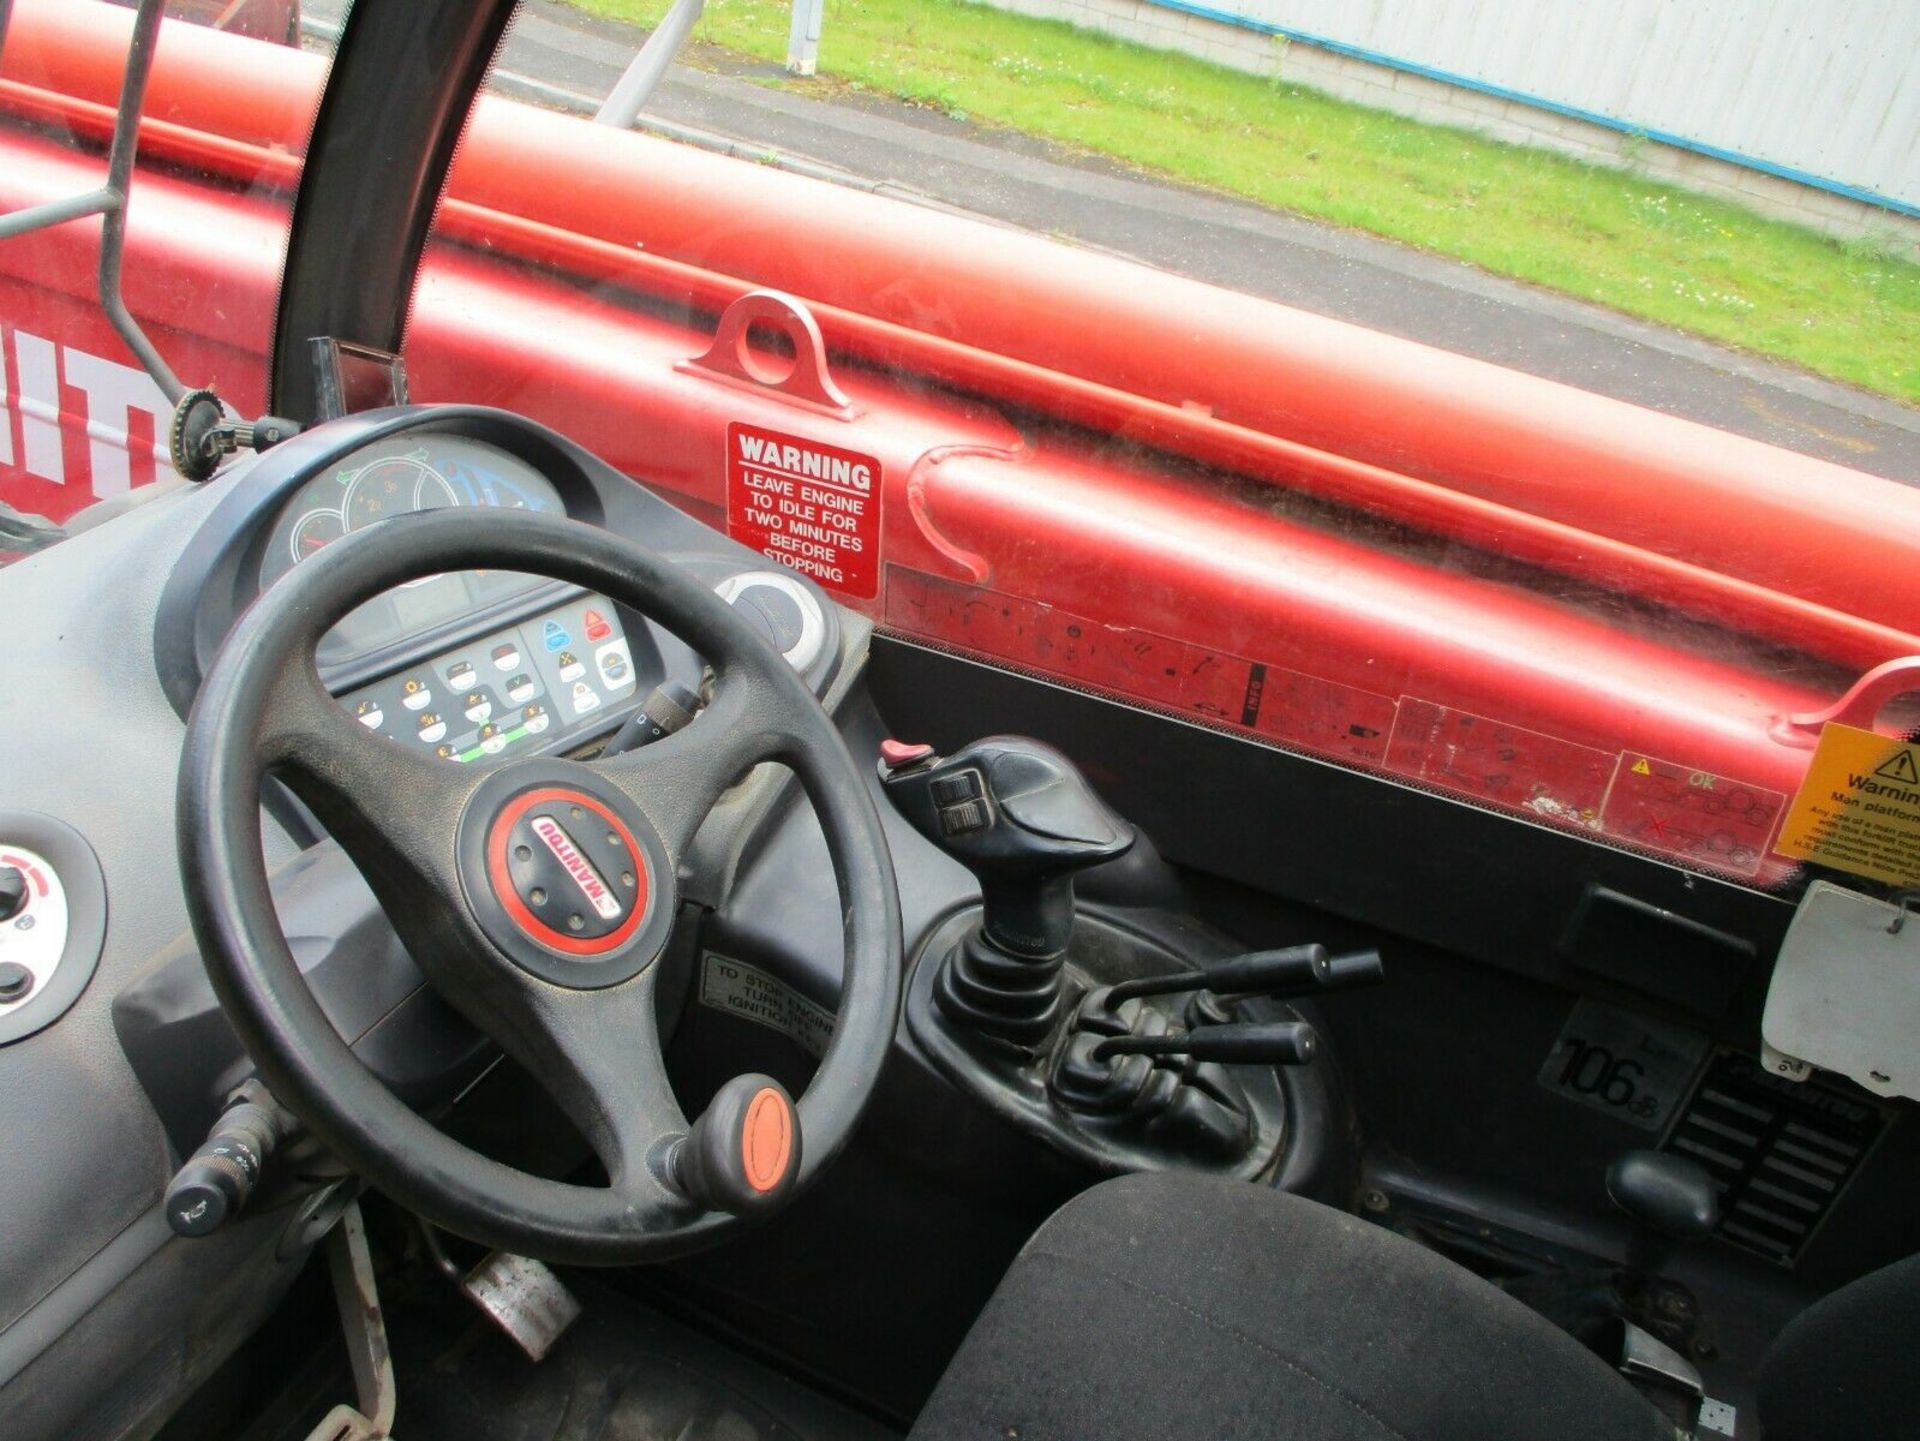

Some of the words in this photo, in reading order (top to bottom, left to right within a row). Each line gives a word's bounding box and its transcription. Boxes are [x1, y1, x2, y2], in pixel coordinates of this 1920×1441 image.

[738, 433, 871, 490] WARNING
[743, 471, 794, 496] LEAVE
[801, 486, 864, 515] ENGINE
[751, 490, 773, 509] TO
[779, 498, 815, 522] IDLE
[821, 509, 857, 532] FOR
[744, 507, 783, 528] TWO
[789, 519, 863, 552] MINUTES
[770, 531, 836, 563] BEFORE
[763, 547, 843, 583] STOPPING
[1688, 771, 1717, 790] OK
[1831, 790, 1860, 808] Man
[1848, 773, 1920, 805] Warnin
[538, 822, 606, 899] MANITOU
[717, 965, 739, 980] TO
[745, 974, 783, 997] STOP
[1558, 1037, 1645, 1106] 106
